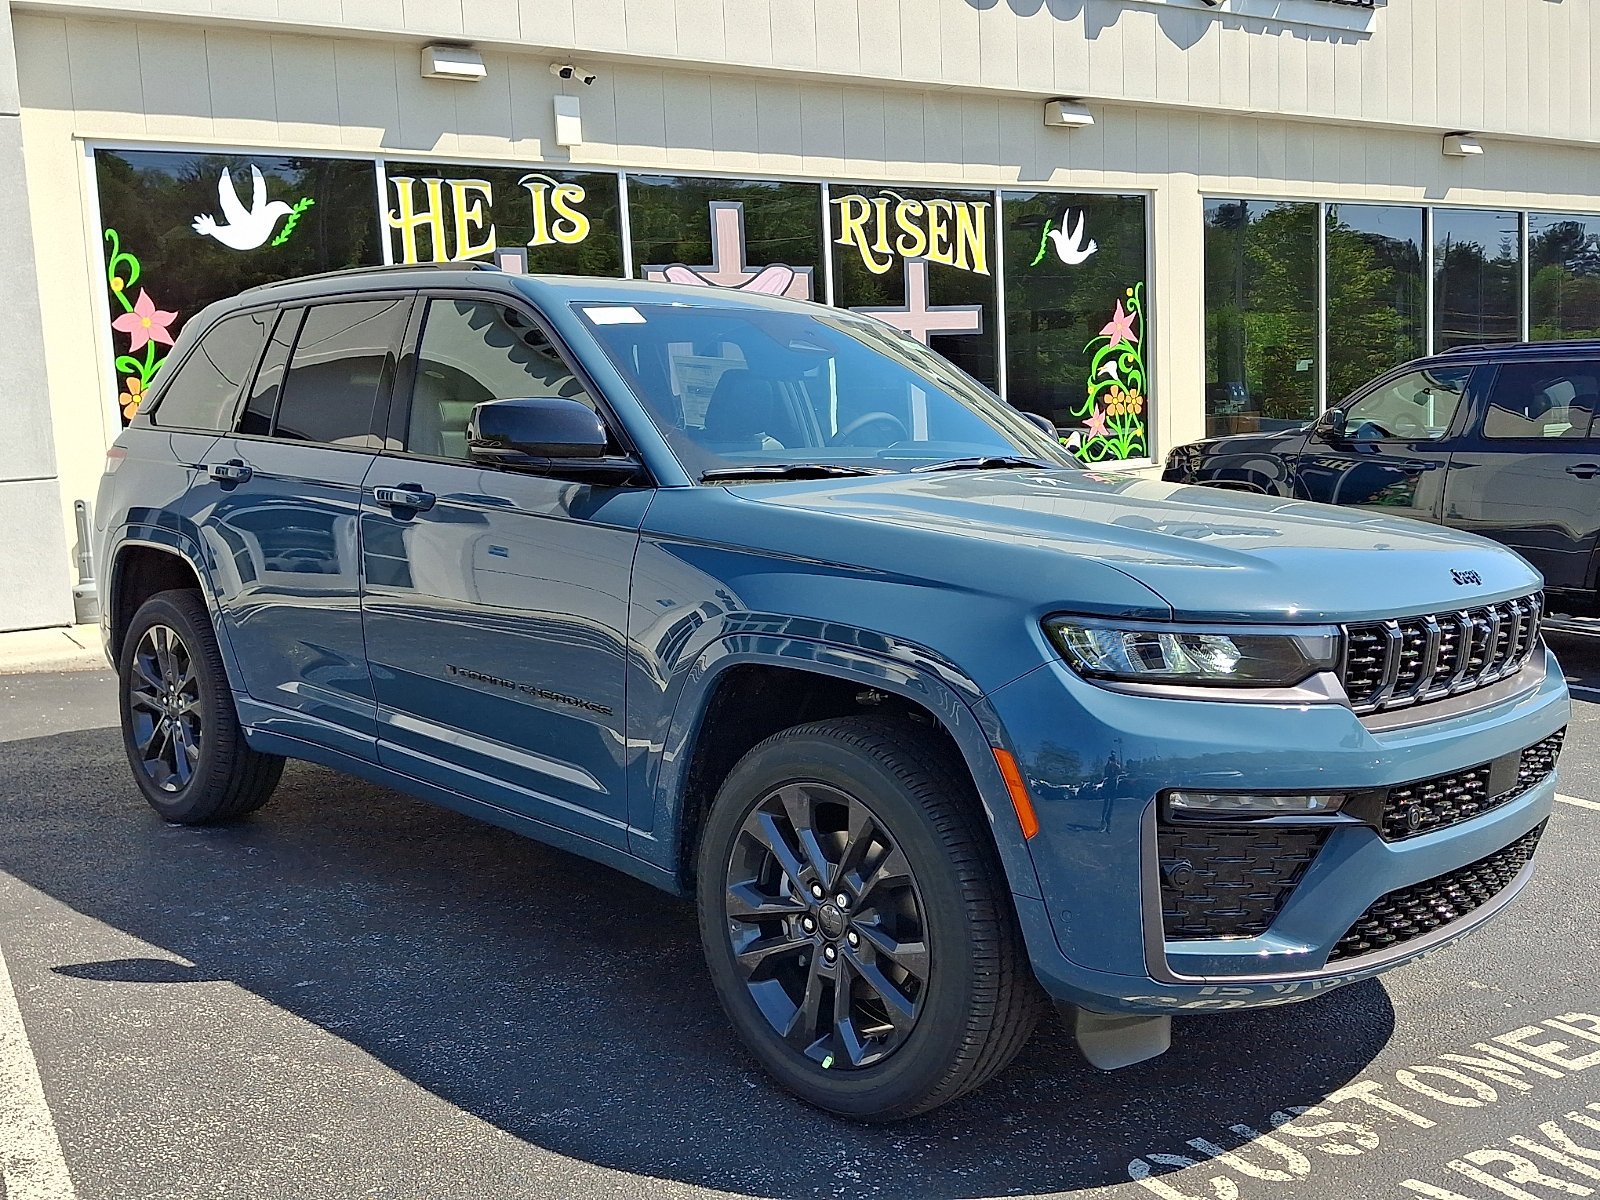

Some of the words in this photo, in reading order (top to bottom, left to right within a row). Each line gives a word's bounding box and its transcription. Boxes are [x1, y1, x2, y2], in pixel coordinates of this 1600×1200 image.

[388, 176, 497, 264] HE
[517, 173, 591, 248] IS
[829, 189, 992, 277] RISEN
[1449, 568, 1482, 586] Jeep
